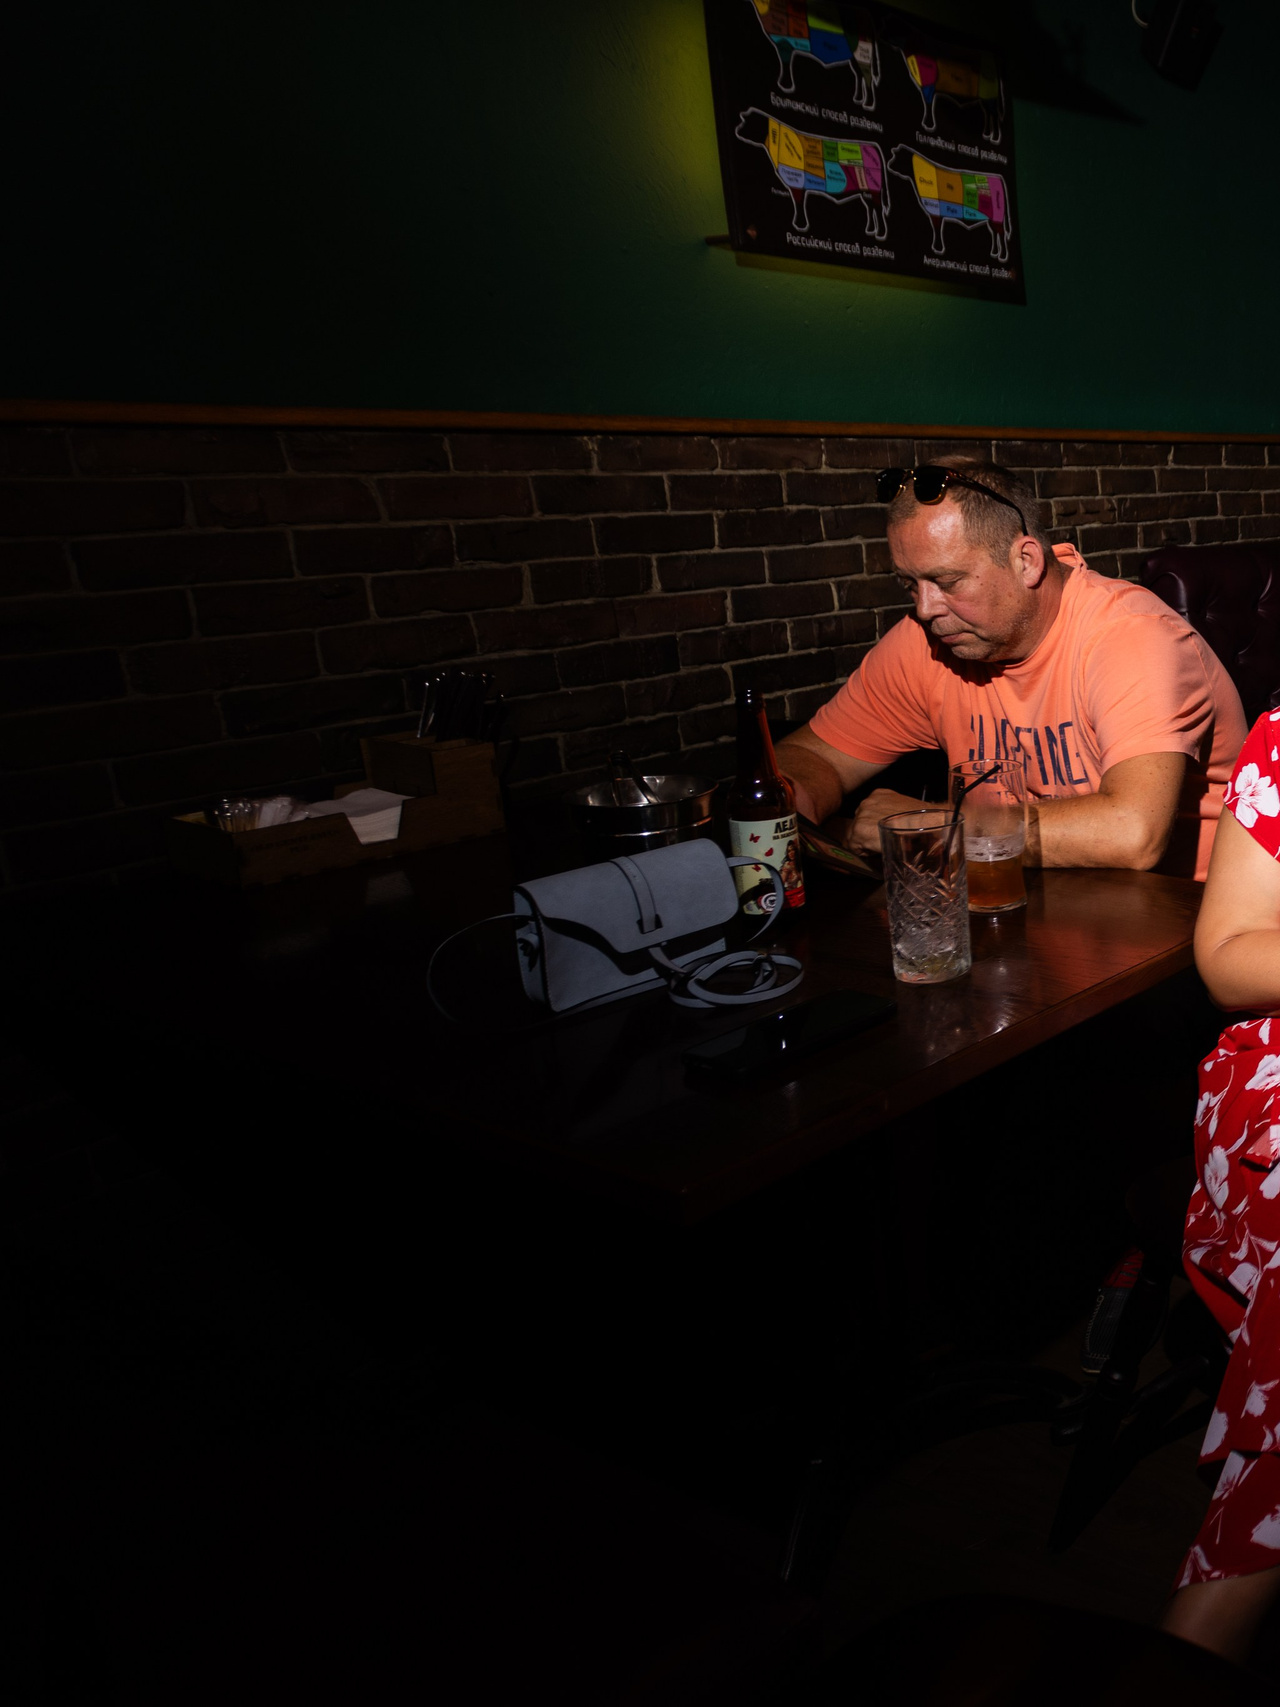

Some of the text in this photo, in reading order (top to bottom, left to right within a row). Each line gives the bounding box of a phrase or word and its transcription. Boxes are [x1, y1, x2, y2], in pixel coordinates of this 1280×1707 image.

[821, 108, 849, 125] способ
[786, 231, 895, 261] Российский способ разделки
